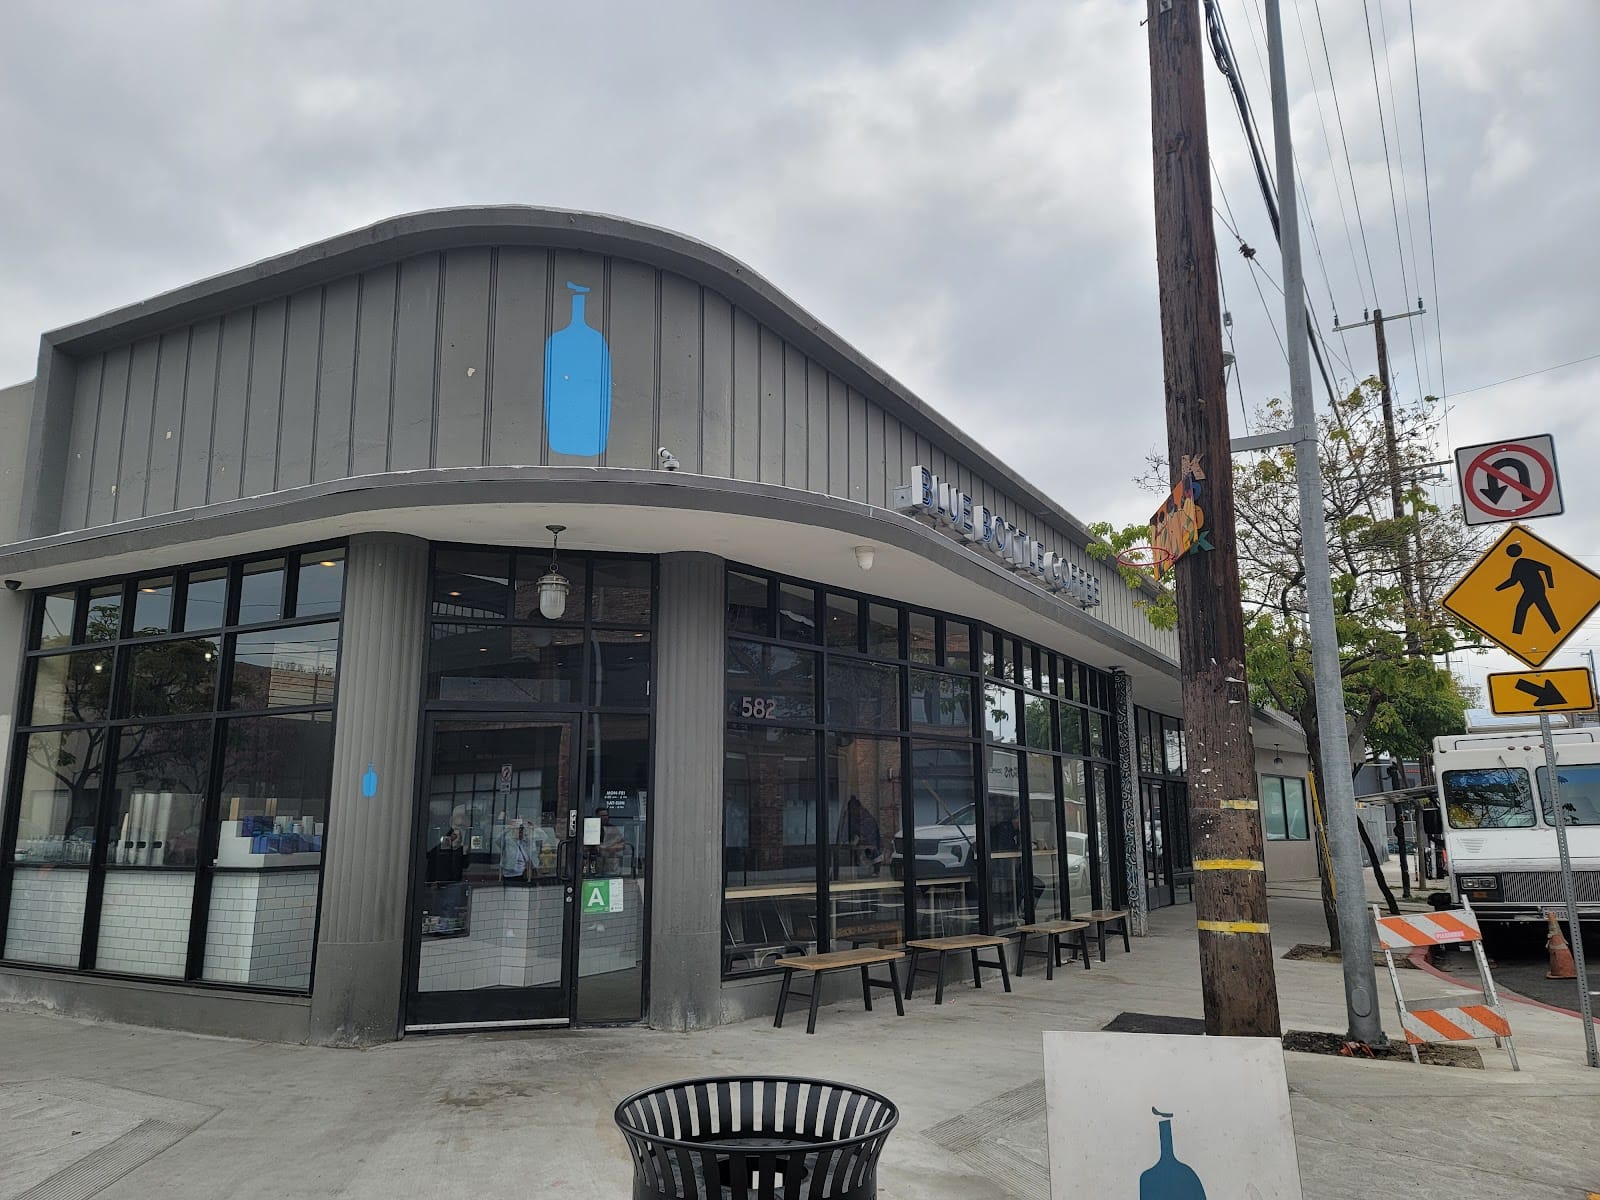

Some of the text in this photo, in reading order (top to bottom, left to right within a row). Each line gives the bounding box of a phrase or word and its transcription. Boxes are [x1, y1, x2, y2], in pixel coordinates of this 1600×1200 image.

[911, 465, 1101, 607] BLUE BOTTLE COFFEE
[742, 696, 777, 720] 582
[587, 887, 605, 907] A
